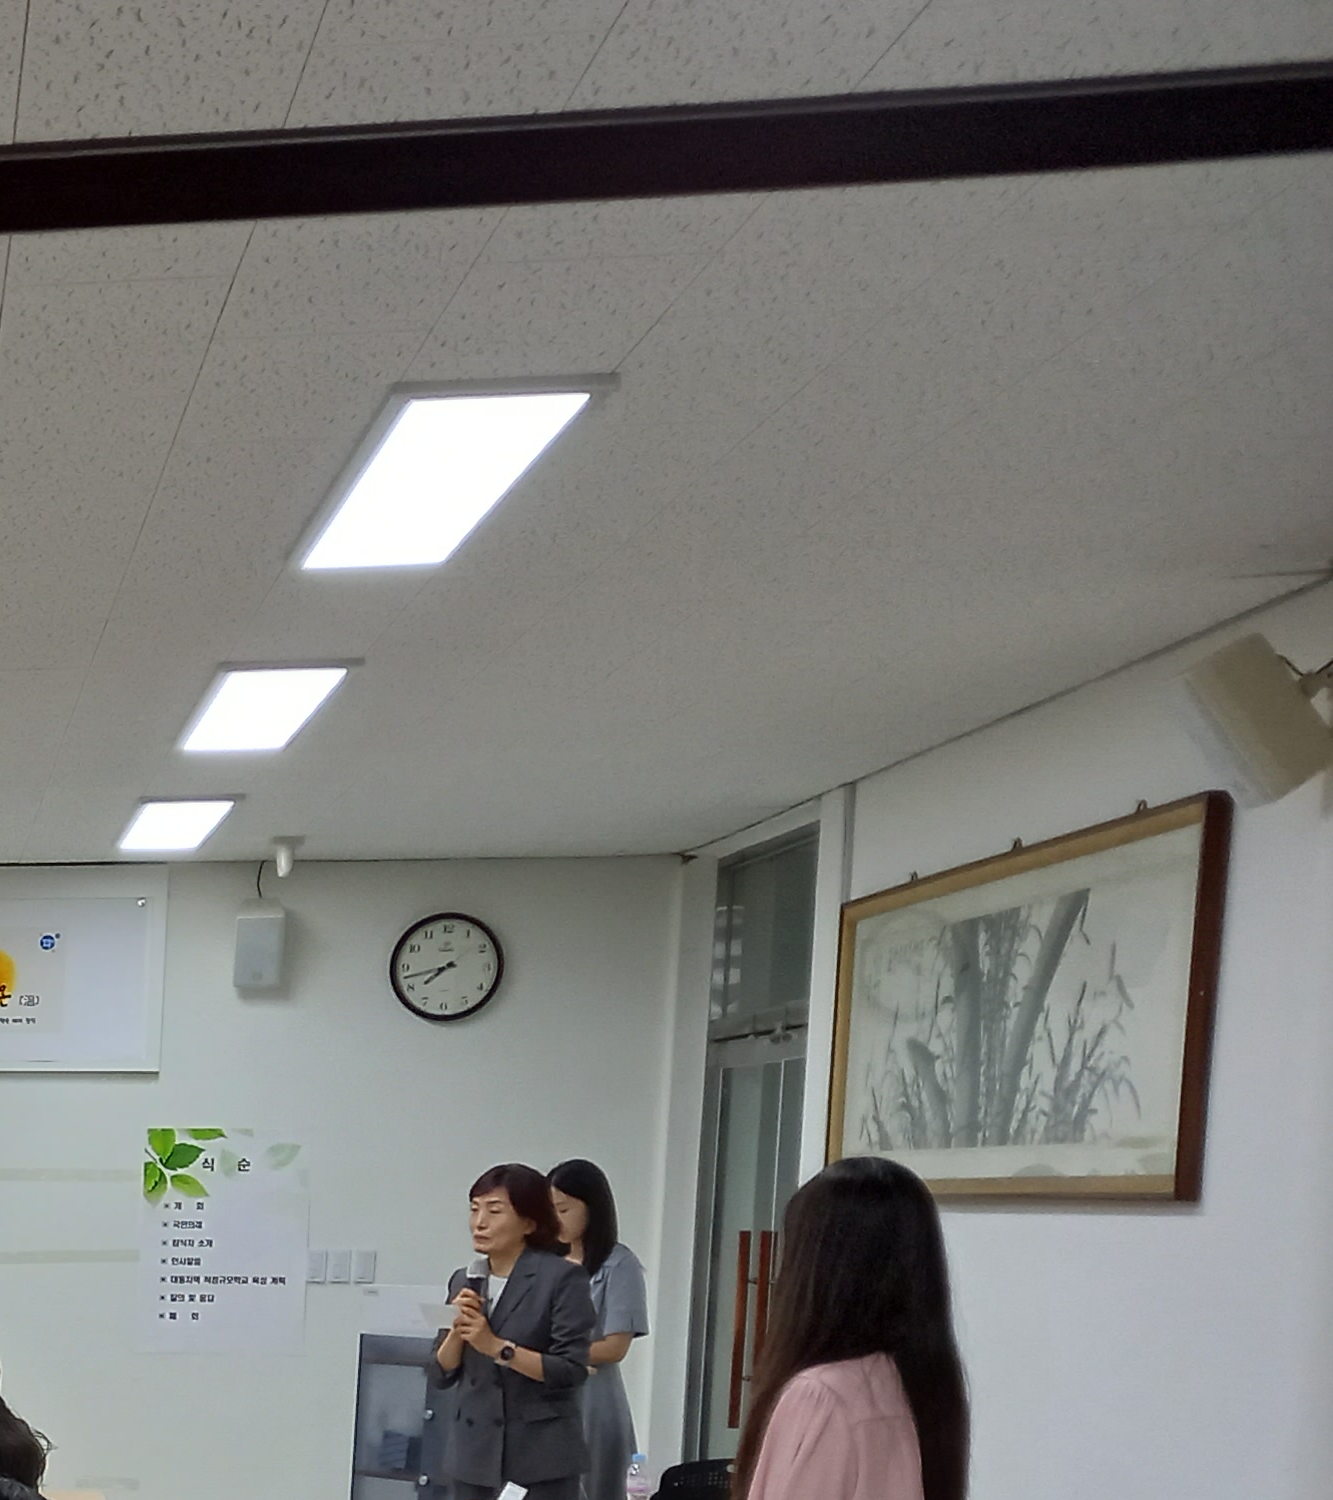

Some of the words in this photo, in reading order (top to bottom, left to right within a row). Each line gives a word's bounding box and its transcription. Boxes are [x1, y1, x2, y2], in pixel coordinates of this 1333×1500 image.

[443, 924, 455, 933] 12
[466, 928, 471, 938] 1
[424, 930, 433, 939] 11
[409, 944, 421, 953] 10
[478, 943, 487, 953] 2
[402, 963, 410, 972] 9
[483, 963, 491, 972] 3
[406, 983, 415, 992] 8
[477, 982, 484, 991] 4
[421, 996, 429, 1007] 7
[461, 996, 469, 1005] 5
[439, 1002, 448, 1011] 6
[202, 1158, 215, 1172] 식
[237, 1158, 251, 1172] 순
